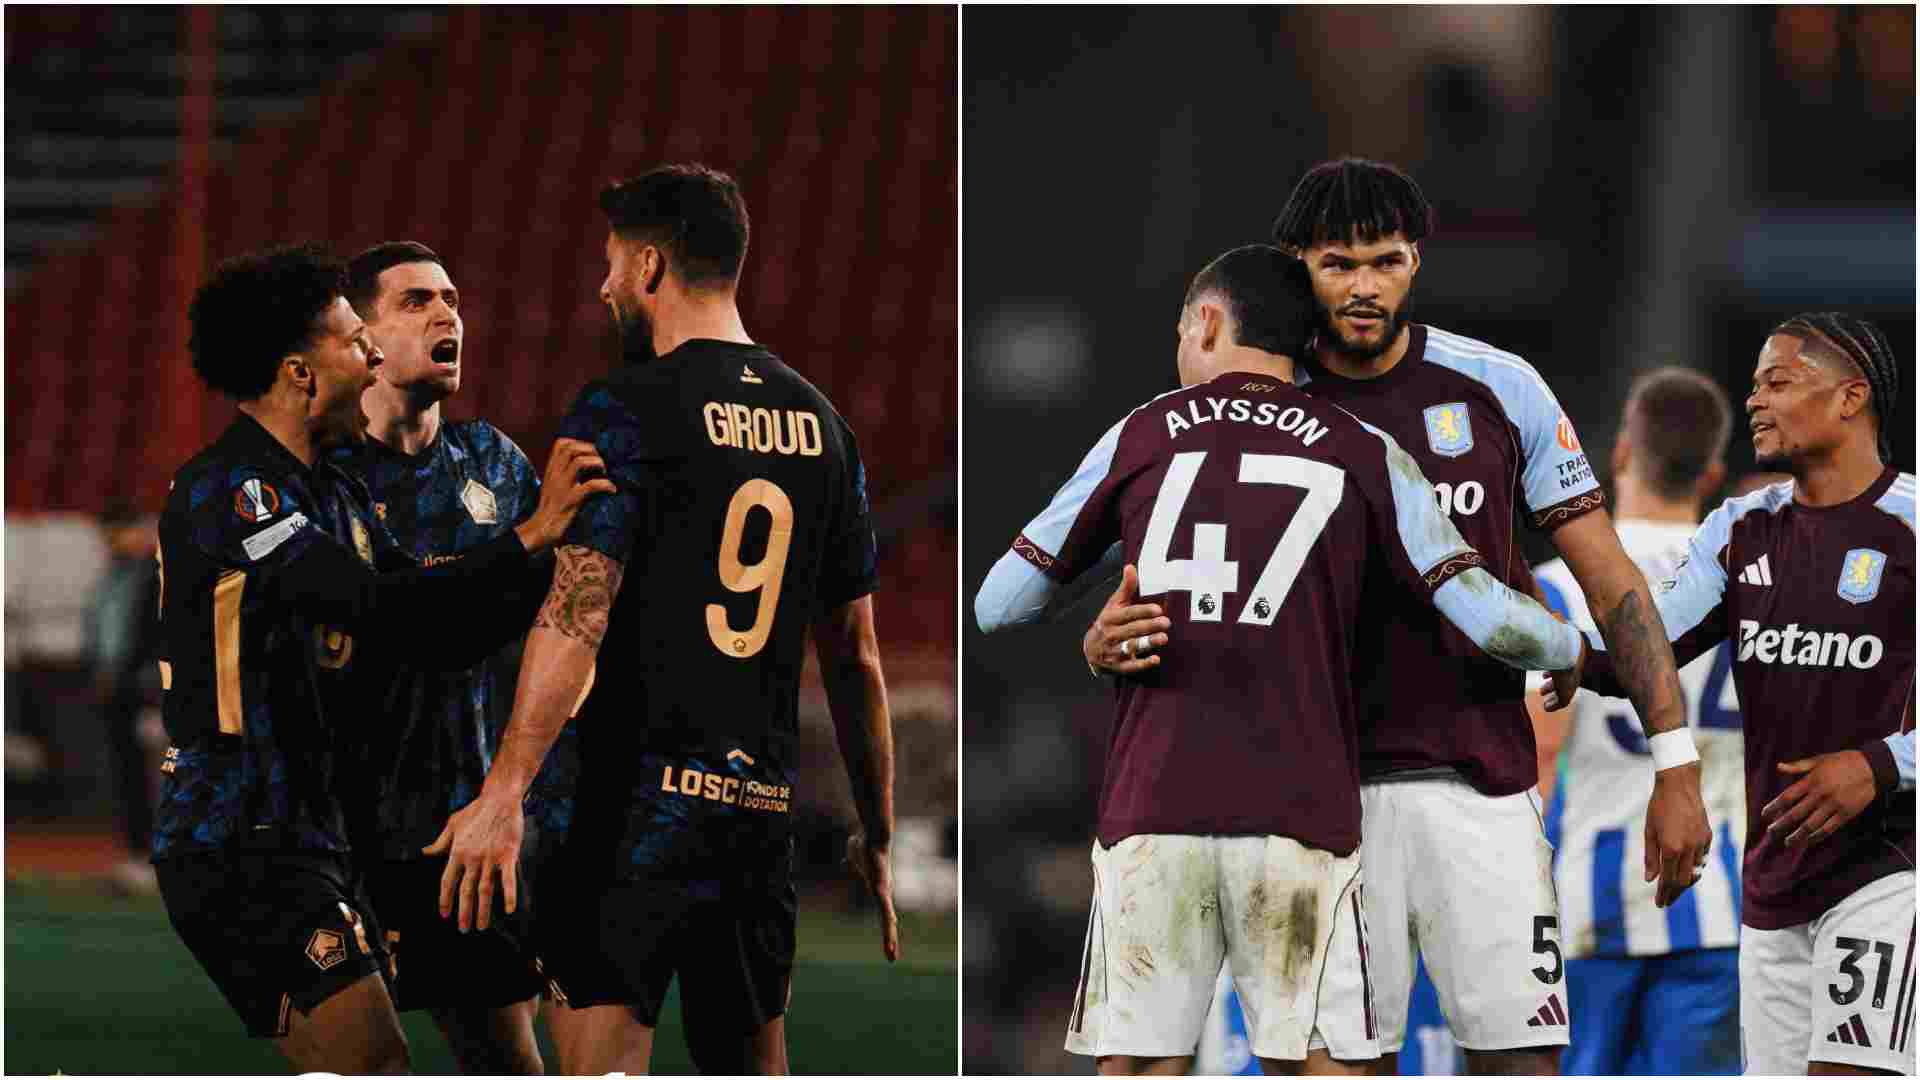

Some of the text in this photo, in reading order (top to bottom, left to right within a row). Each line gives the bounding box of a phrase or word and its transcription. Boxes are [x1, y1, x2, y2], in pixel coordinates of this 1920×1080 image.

[704, 401, 823, 457] GIROUD
[1164, 398, 1329, 447] ALYSSON
[1137, 451, 1345, 626] 47
[705, 478, 794, 659] 9
[1737, 619, 1884, 669] Betano
[661, 766, 739, 804] LOSC
[744, 797, 789, 813] DOTATION
[1531, 915, 1562, 985] 5
[1827, 936, 1895, 1010] 31
